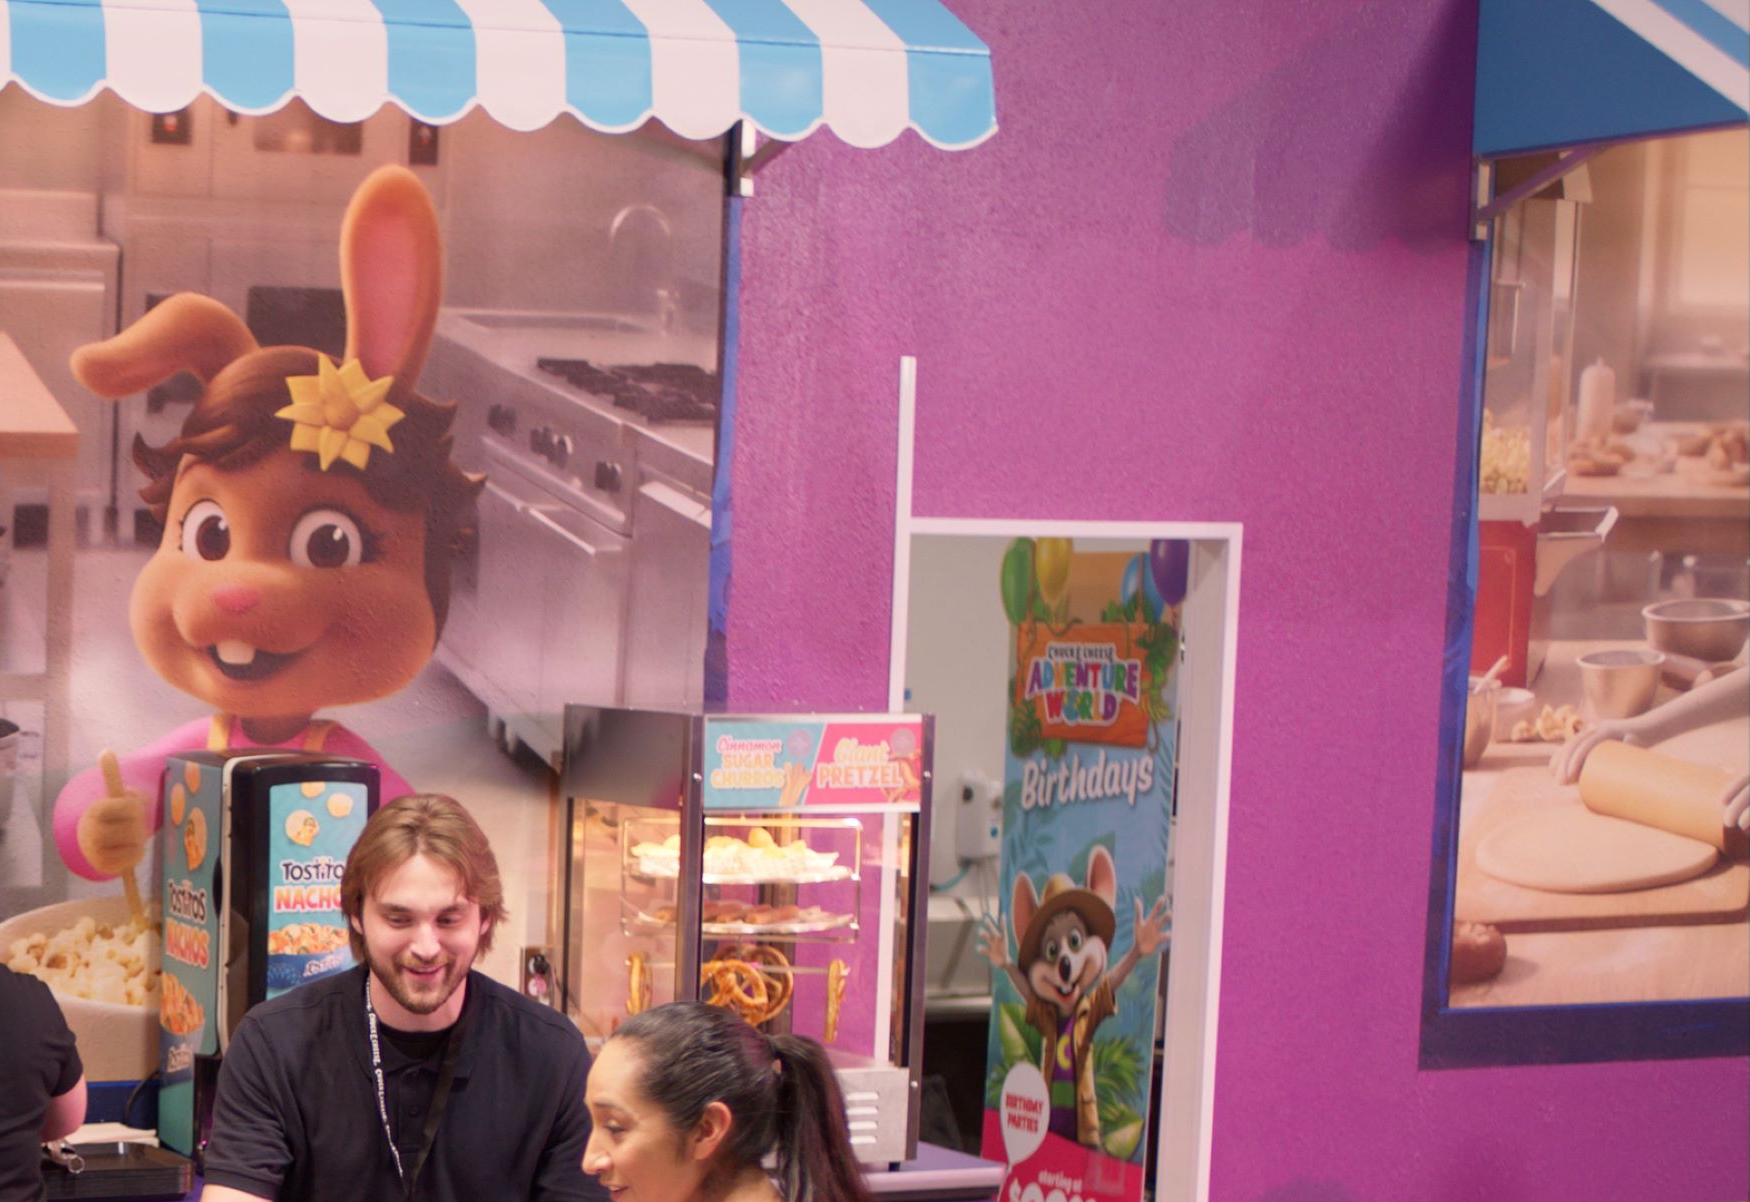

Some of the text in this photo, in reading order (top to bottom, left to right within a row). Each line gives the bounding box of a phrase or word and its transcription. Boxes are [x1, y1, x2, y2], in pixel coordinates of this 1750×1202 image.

[1029, 660, 1140, 699] ADVENTURE
[1046, 690, 1118, 721] WORLD
[718, 737, 782, 751] Cinnamon
[835, 740, 890, 762] Giant
[724, 753, 774, 769] SUGAR
[712, 771, 786, 787] CHURROS
[818, 763, 902, 787] PRETZEL
[1022, 754, 1154, 810] Birthdays
[282, 857, 345, 881] TOSTITO
[275, 885, 341, 911] NACHO
[1006, 1093, 1043, 1114] BIRTHDAY
[1007, 1112, 1039, 1134] PARTIES
[1039, 1170, 1072, 1194] starting
